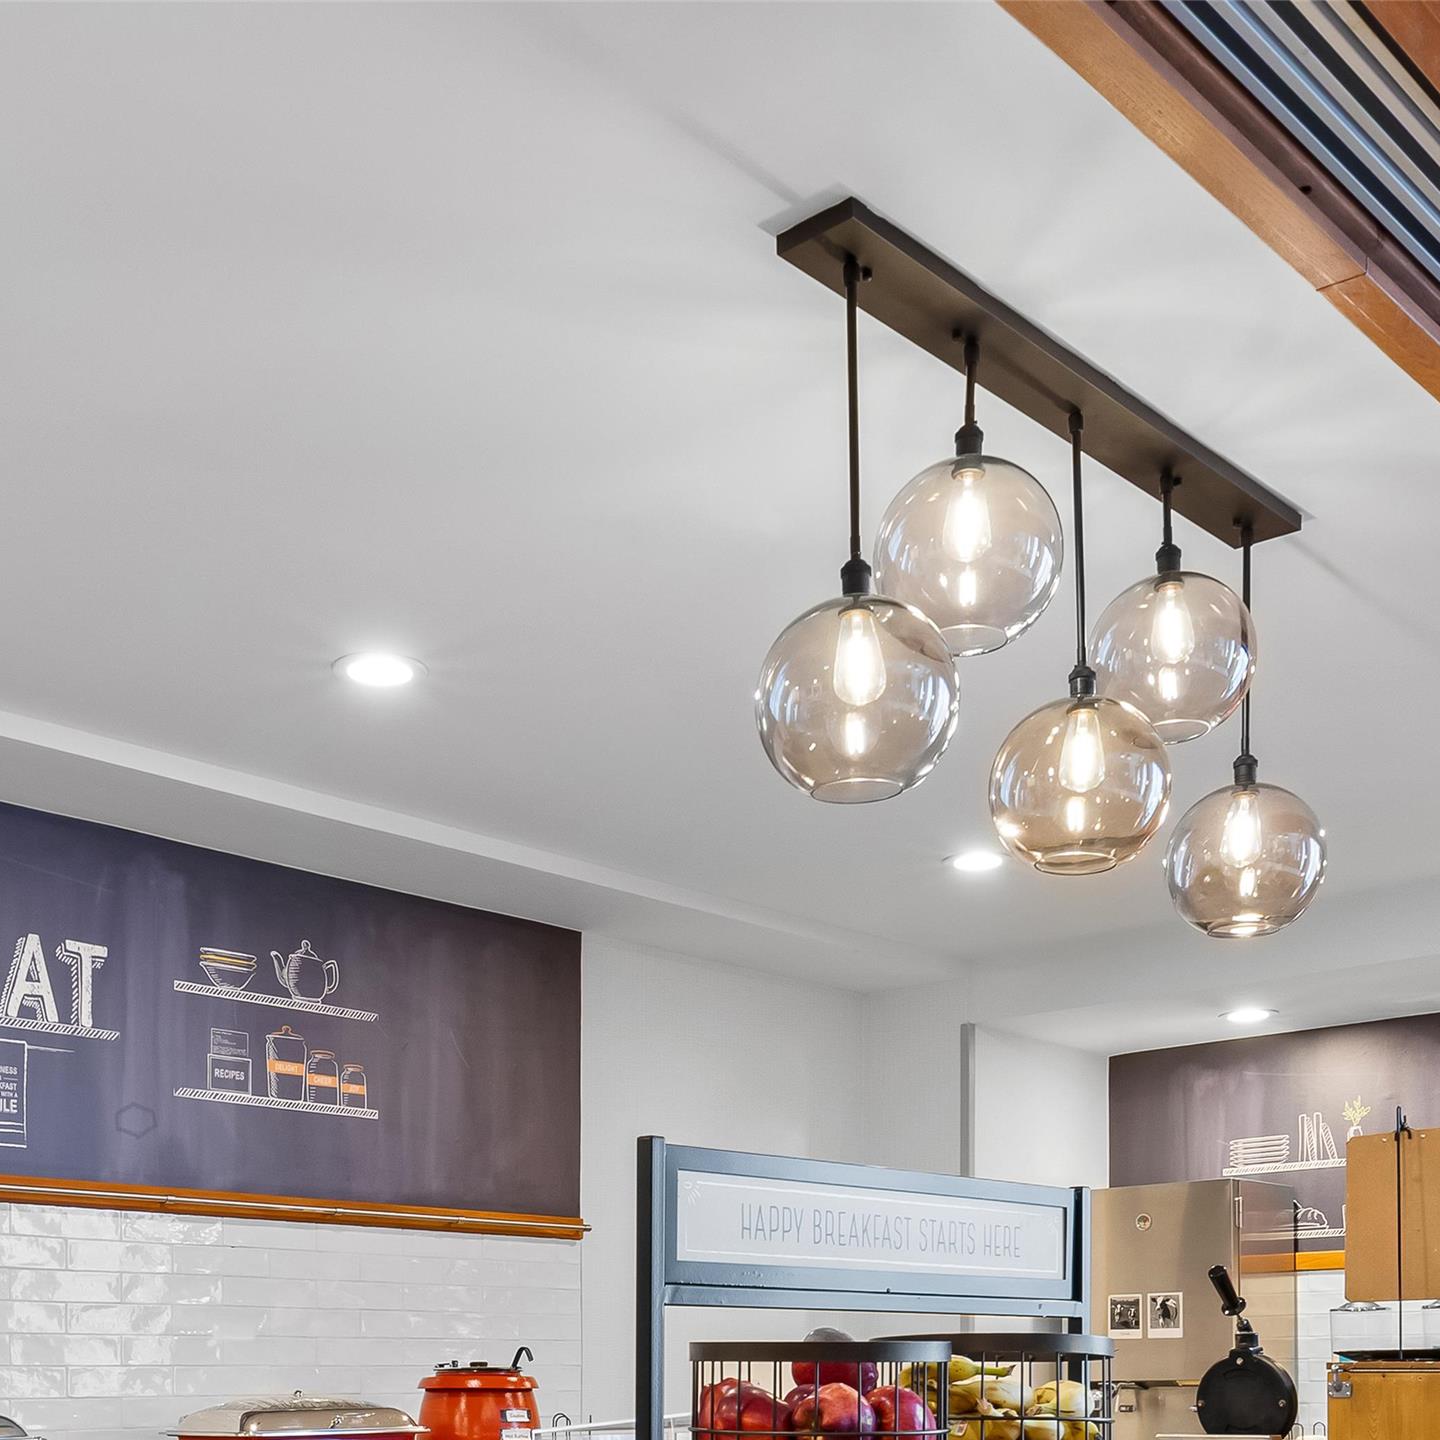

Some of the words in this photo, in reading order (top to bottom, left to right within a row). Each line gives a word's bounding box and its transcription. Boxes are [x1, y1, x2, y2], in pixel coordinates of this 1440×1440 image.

[275, 1062, 298, 1073] DELIGHT
[214, 1068, 245, 1081] RECIPES
[741, 1203, 804, 1243] HAPPY
[813, 1208, 912, 1250] BREAKFAST
[919, 1218, 976, 1255] STARTS
[983, 1224, 1021, 1258] HERE
